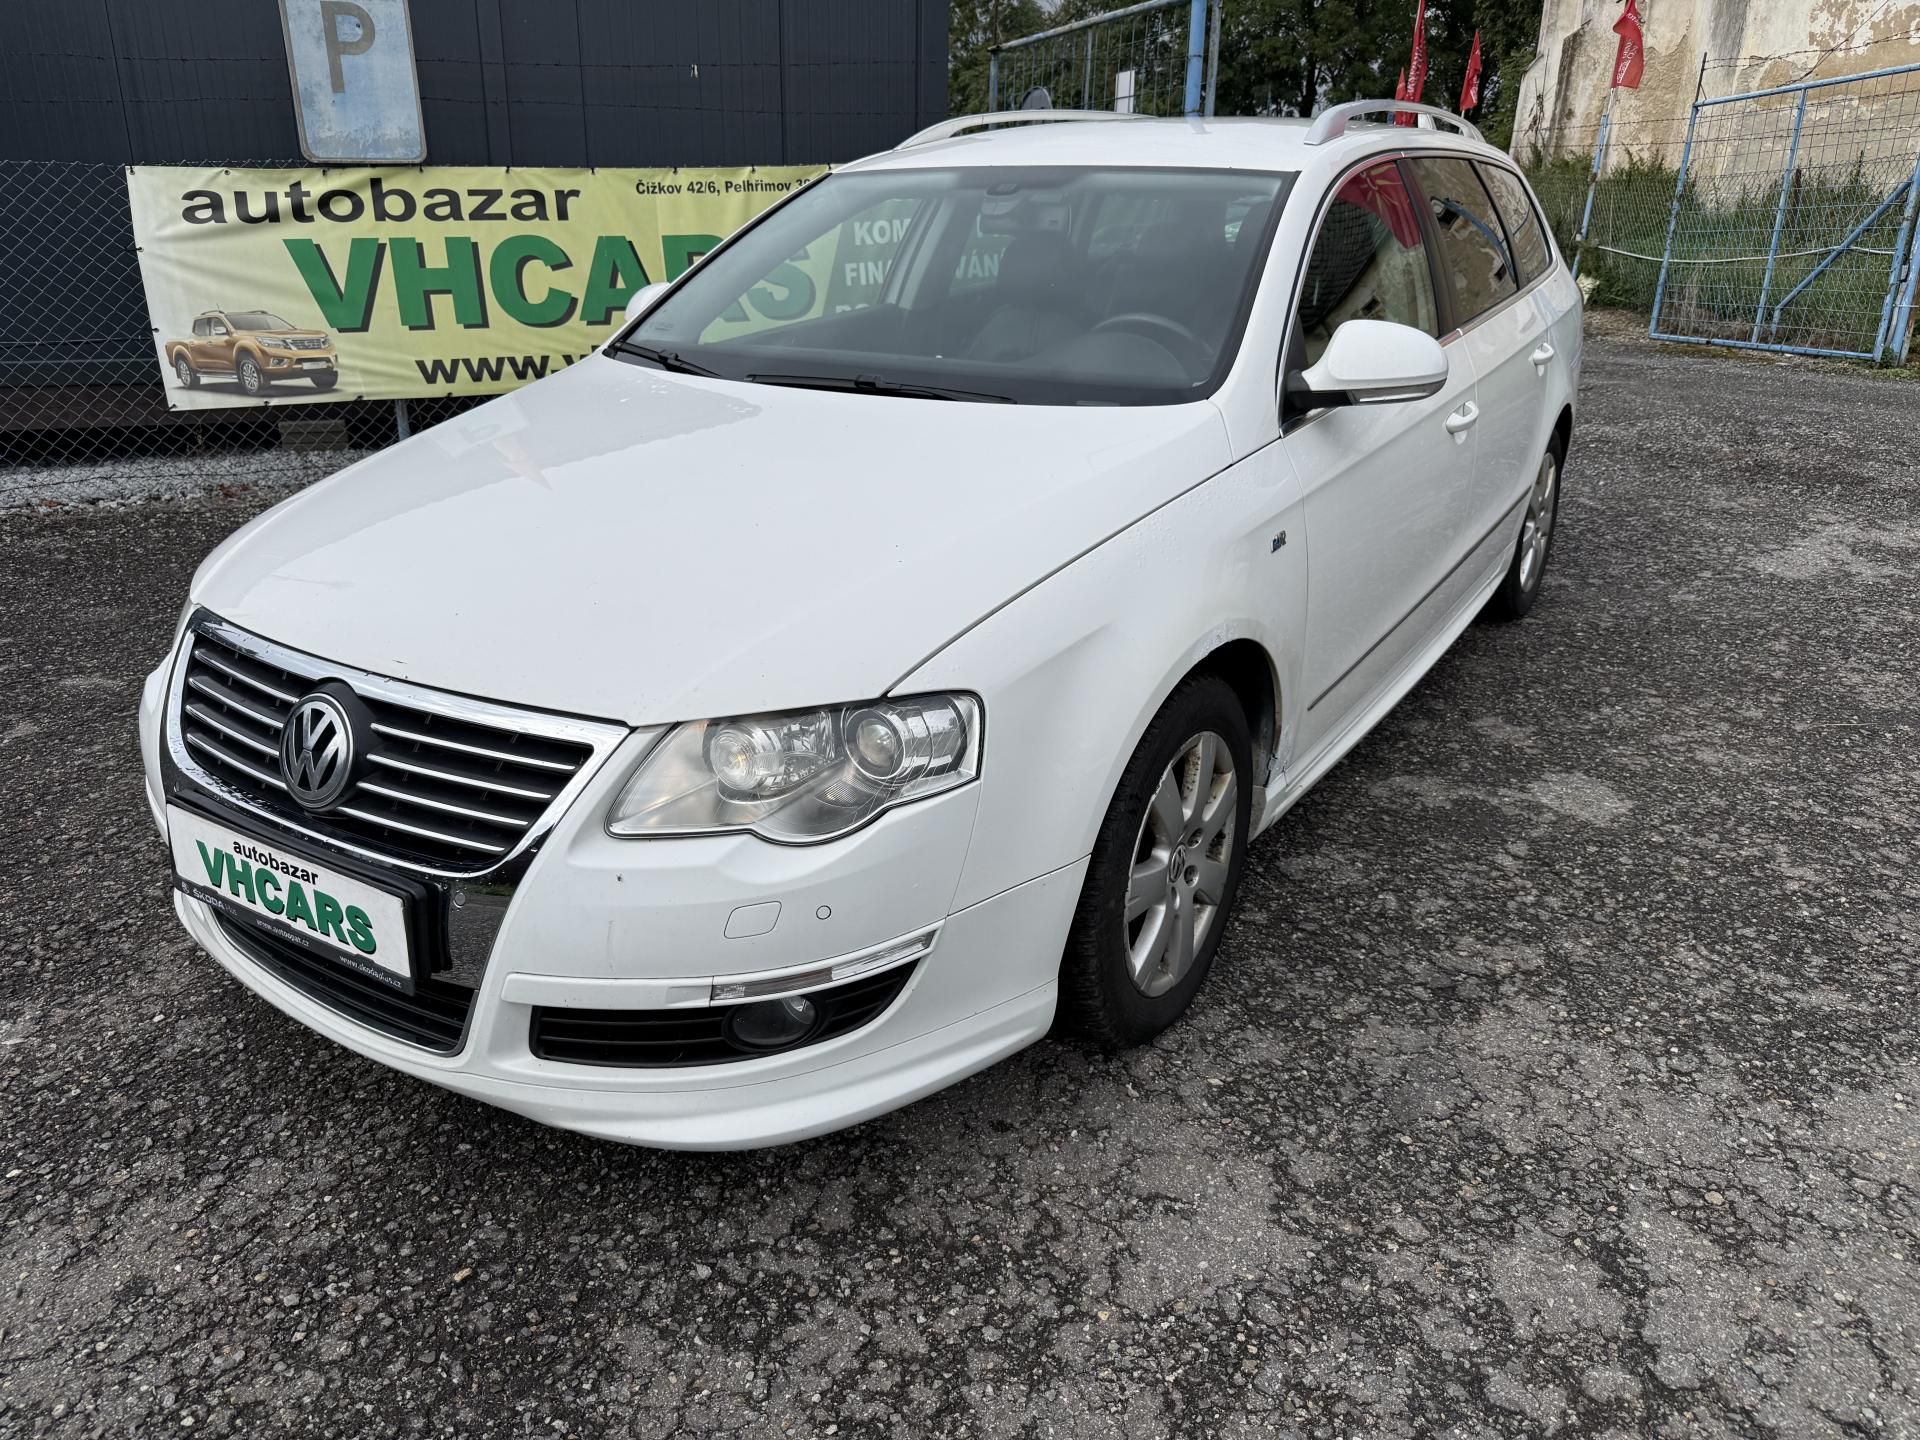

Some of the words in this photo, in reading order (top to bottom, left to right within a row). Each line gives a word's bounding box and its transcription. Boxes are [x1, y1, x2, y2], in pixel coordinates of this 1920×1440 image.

[320, 1, 376, 93] P
[181, 178, 580, 224] autobazar
[636, 180, 682, 194] Čížkov
[687, 181, 720, 196] 42/6,
[725, 180, 791, 193] Pelhřimov
[233, 840, 319, 886] autobazar
[196, 839, 377, 955] VHCARS
